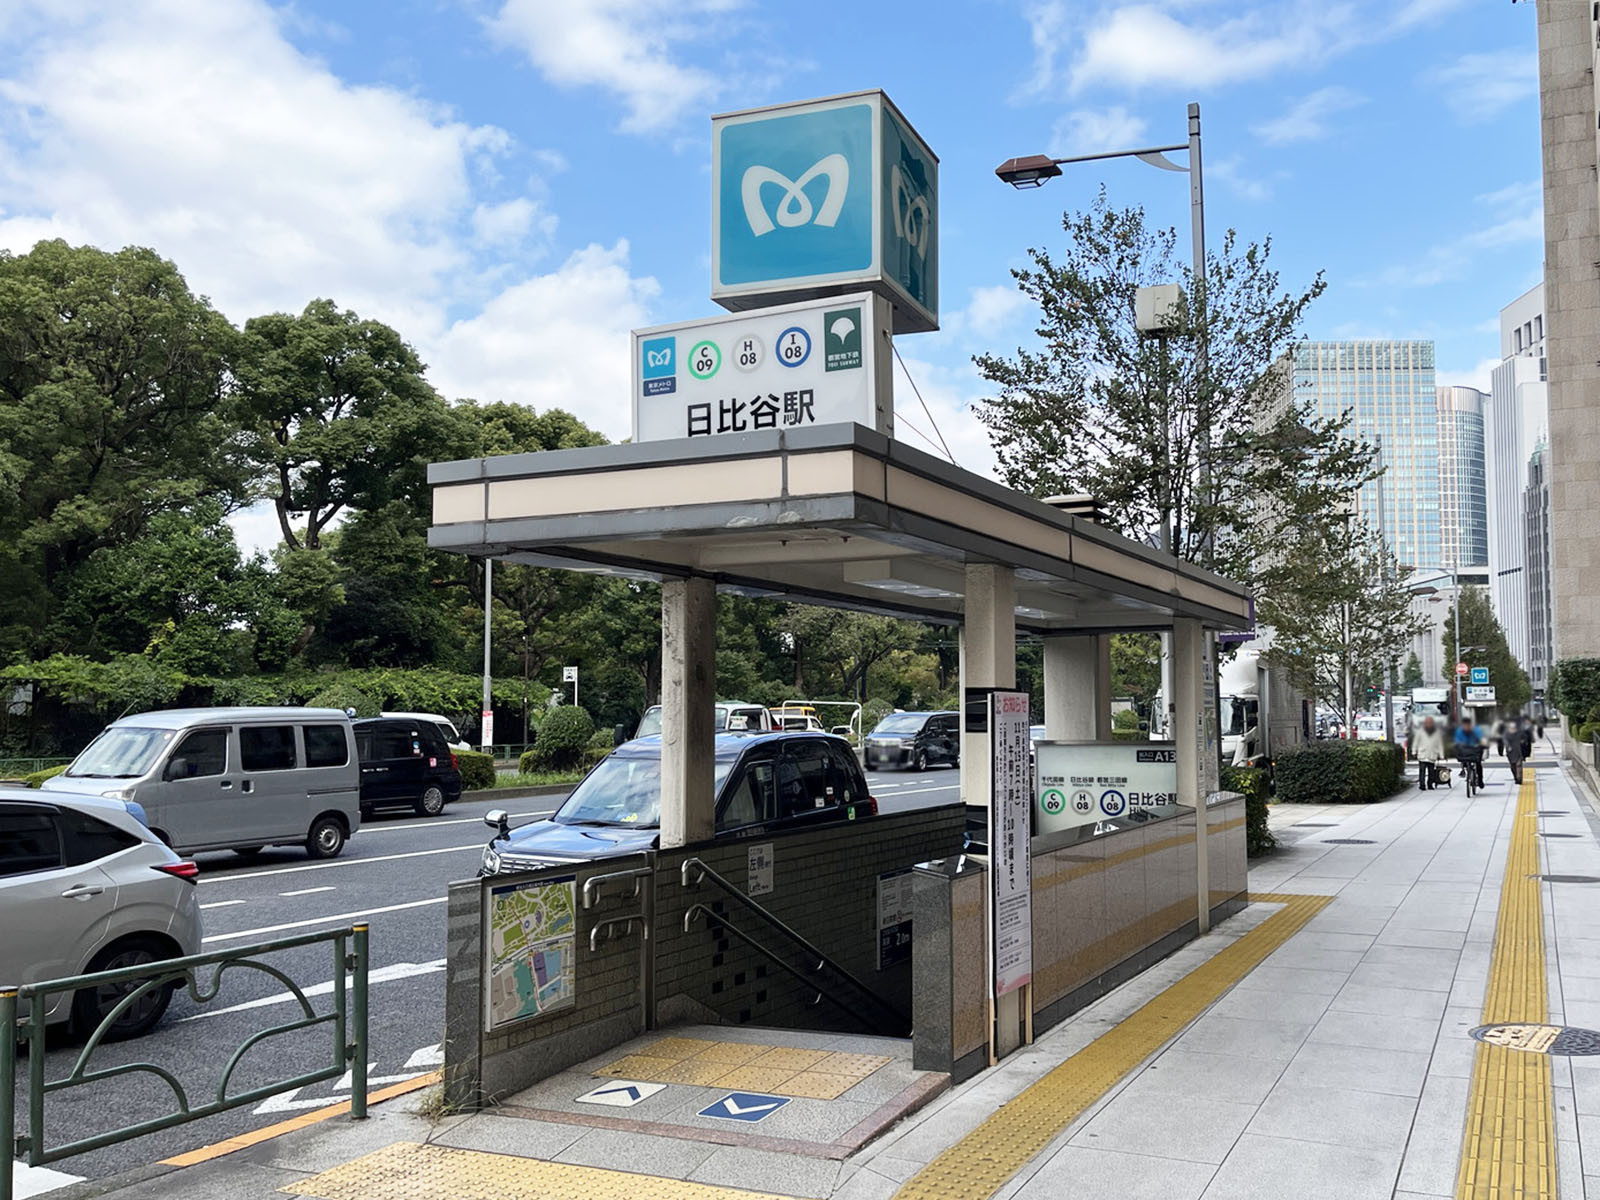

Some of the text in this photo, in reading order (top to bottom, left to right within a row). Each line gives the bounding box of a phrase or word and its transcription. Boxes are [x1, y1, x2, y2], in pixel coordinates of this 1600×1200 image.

[790, 334, 797, 346] I
[743, 341, 754, 352] H
[700, 347, 709, 358] C
[784, 346, 802, 360] 08
[696, 358, 713, 372] 09
[740, 353, 757, 366] 08
[687, 389, 815, 437] 日比谷駅
[1155, 751, 1176, 762] A13
[1050, 793, 1056, 801] C
[1047, 801, 1060, 810] 09
[1076, 802, 1089, 810] 08
[1106, 802, 1119, 811] 08
